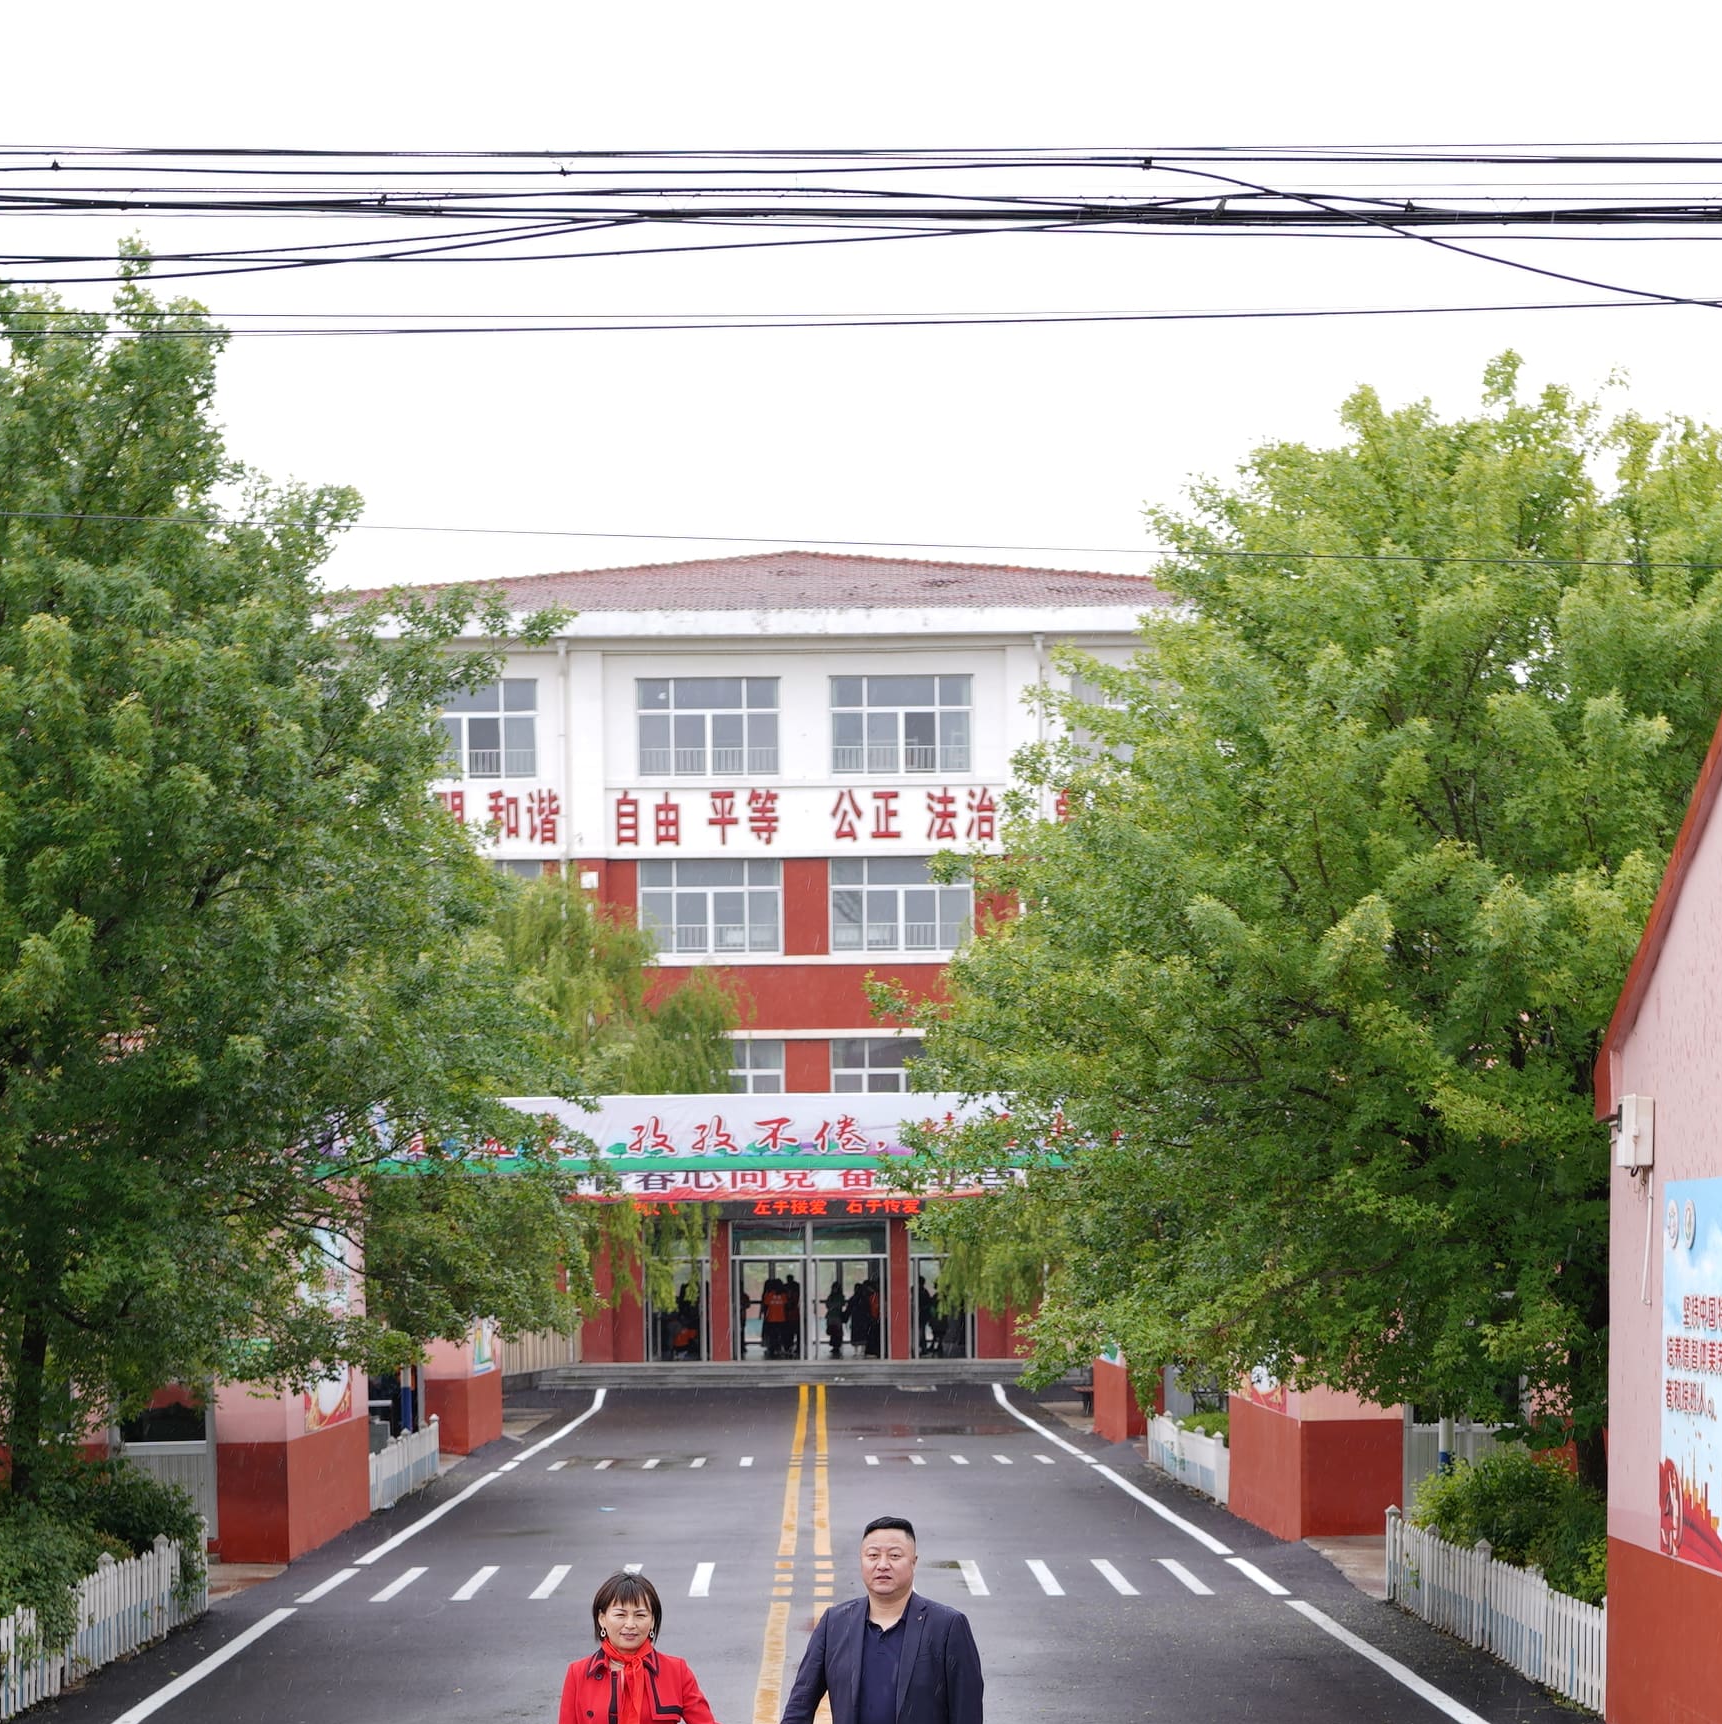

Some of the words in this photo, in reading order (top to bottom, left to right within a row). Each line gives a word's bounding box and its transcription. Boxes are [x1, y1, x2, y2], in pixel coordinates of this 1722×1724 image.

[488, 789, 561, 844] 和谐
[615, 796, 681, 846] 自由
[707, 789, 780, 845] 平等
[832, 790, 902, 842] 公正
[927, 788, 996, 841] 法治
